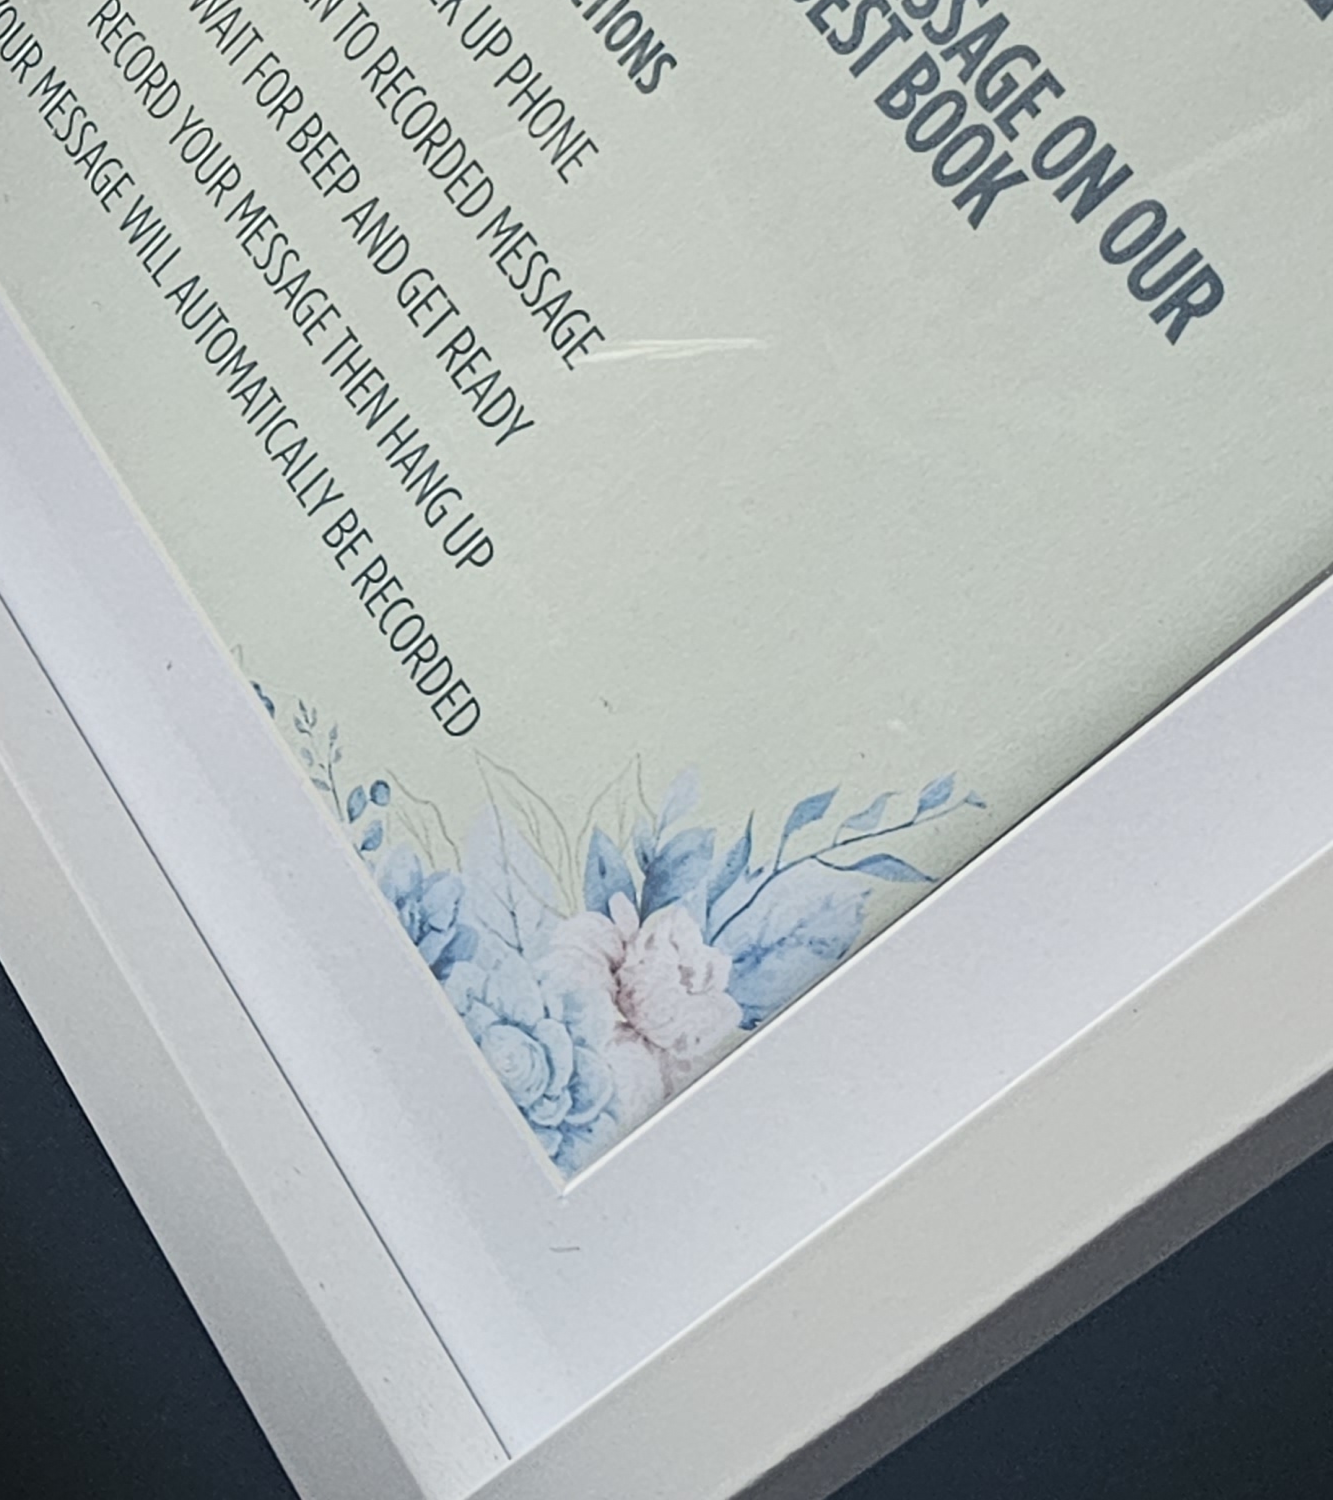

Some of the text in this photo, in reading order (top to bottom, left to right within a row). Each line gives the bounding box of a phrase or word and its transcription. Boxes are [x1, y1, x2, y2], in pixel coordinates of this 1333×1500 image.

[242, 52, 303, 131] FOR
[286, 112, 360, 197] BEEP
[341, 197, 410, 275] AND
[397, 268, 460, 338] GET
[436, 326, 535, 447] READY
[333, 2, 380, 60] TO
[361, 46, 494, 218] RECORDED
[476, 205, 605, 371] MESSAGE
[460, 4, 513, 61] UP
[493, 53, 599, 184] PHONE
[874, 51, 1030, 230] BOOK
[1031, 115, 1134, 224] ON
[1098, 198, 1226, 346] OUR
[28, 66, 135, 213] MESSAGE
[120, 194, 181, 287] WILL
[165, 275, 344, 517] AUTOMATICALLY
[322, 508, 374, 571] BE
[351, 555, 481, 737] RECORDED
[169, 105, 242, 207] YOUR
[225, 190, 341, 346] MESSAGE
[322, 326, 399, 430] THEN
[376, 414, 462, 528] HANG
[443, 513, 494, 569] UP
